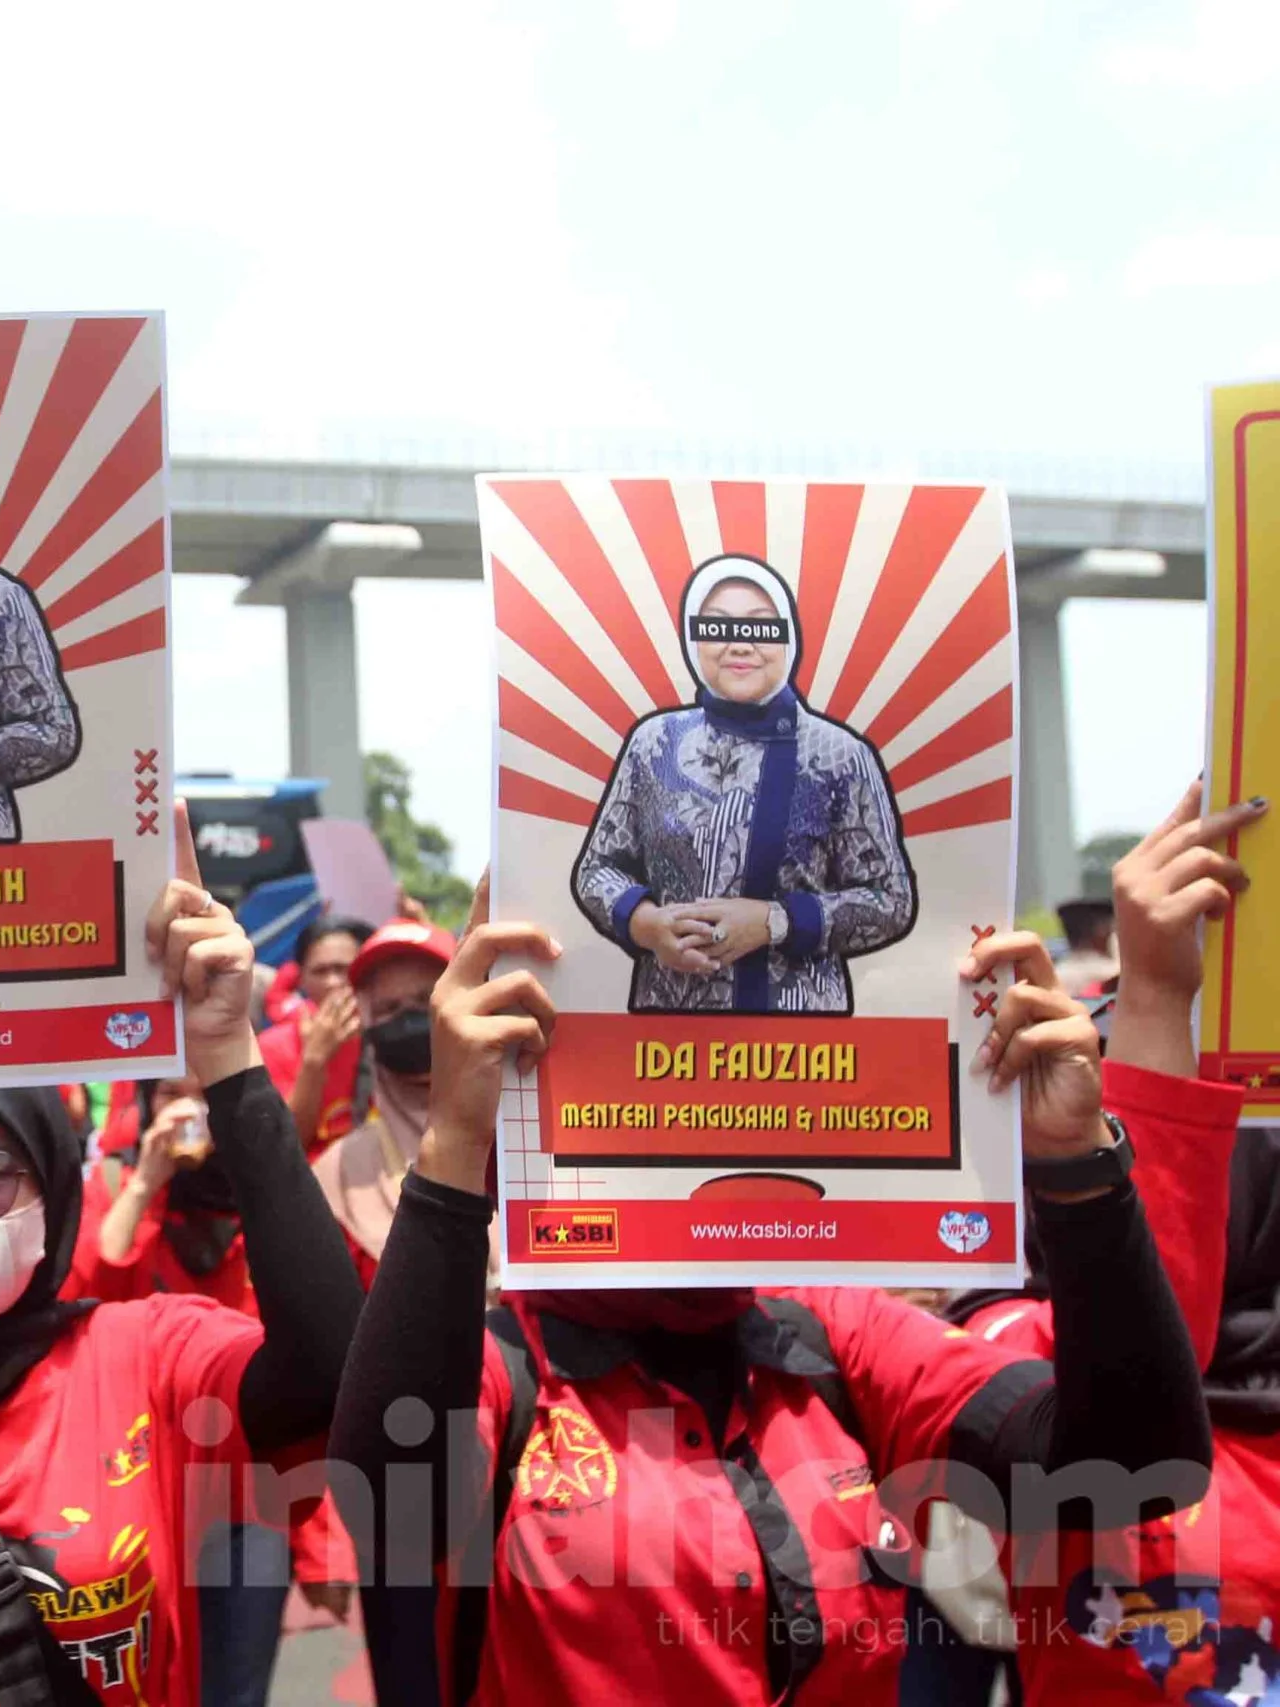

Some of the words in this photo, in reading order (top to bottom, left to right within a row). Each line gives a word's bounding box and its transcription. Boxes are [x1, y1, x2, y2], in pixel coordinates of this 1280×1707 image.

[698, 623, 727, 637] NOT
[733, 624, 780, 638] FOUND
[634, 1041, 696, 1081] IDA
[708, 1042, 857, 1081] FAUZIAH
[560, 1103, 656, 1129] MENTERI
[664, 1104, 787, 1130] PENGUSAHA
[797, 1105, 813, 1132] &
[821, 1105, 931, 1131] INVESTOR
[690, 1220, 837, 1240] www.kasbi.or.id
